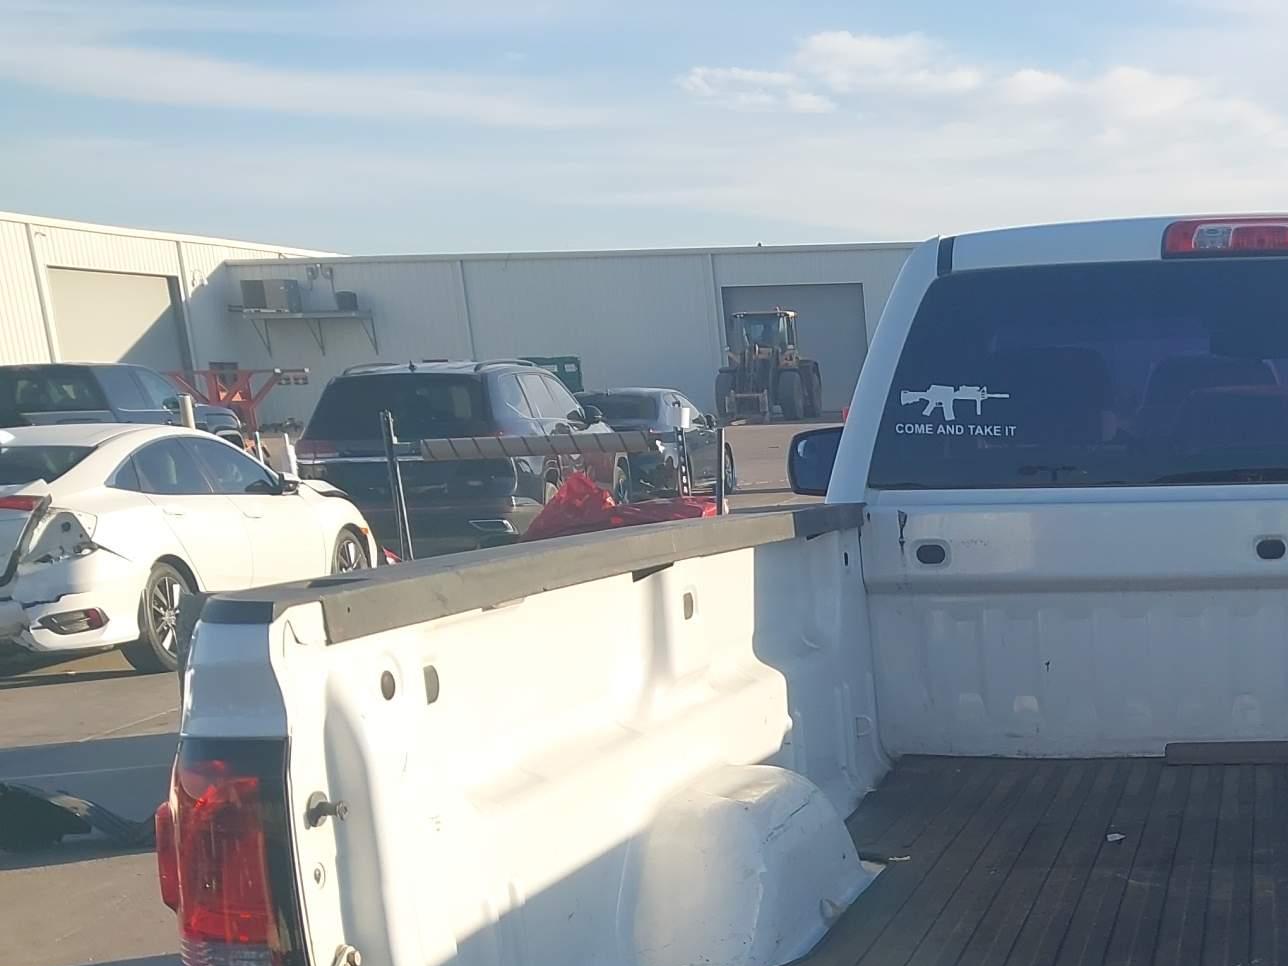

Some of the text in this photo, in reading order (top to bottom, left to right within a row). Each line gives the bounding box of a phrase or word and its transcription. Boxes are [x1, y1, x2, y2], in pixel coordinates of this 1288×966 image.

[895, 423, 1017, 436] COME AND TAKE IT
